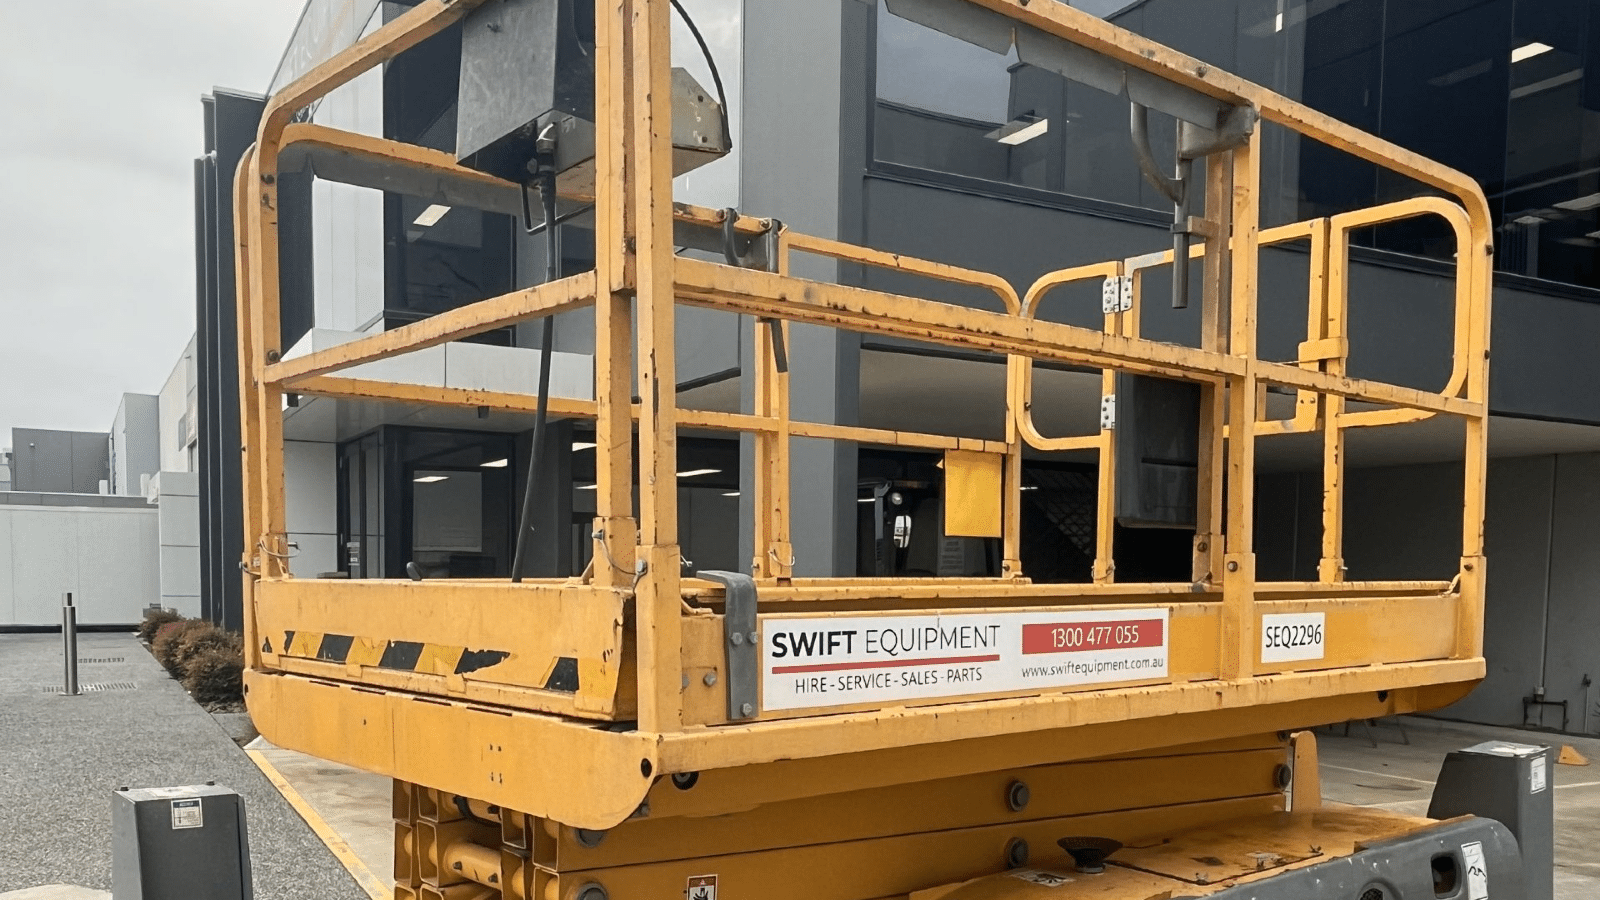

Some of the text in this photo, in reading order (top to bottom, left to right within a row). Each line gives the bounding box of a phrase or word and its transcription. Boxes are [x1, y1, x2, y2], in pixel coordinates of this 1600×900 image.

[772, 625, 1000, 658] SWIFT EQUIPMENT
[1051, 625, 1139, 648] 1300 477 055
[1265, 624, 1321, 649] SEQ2296
[1021, 658, 1164, 678] www.swiftequipment.com.au
